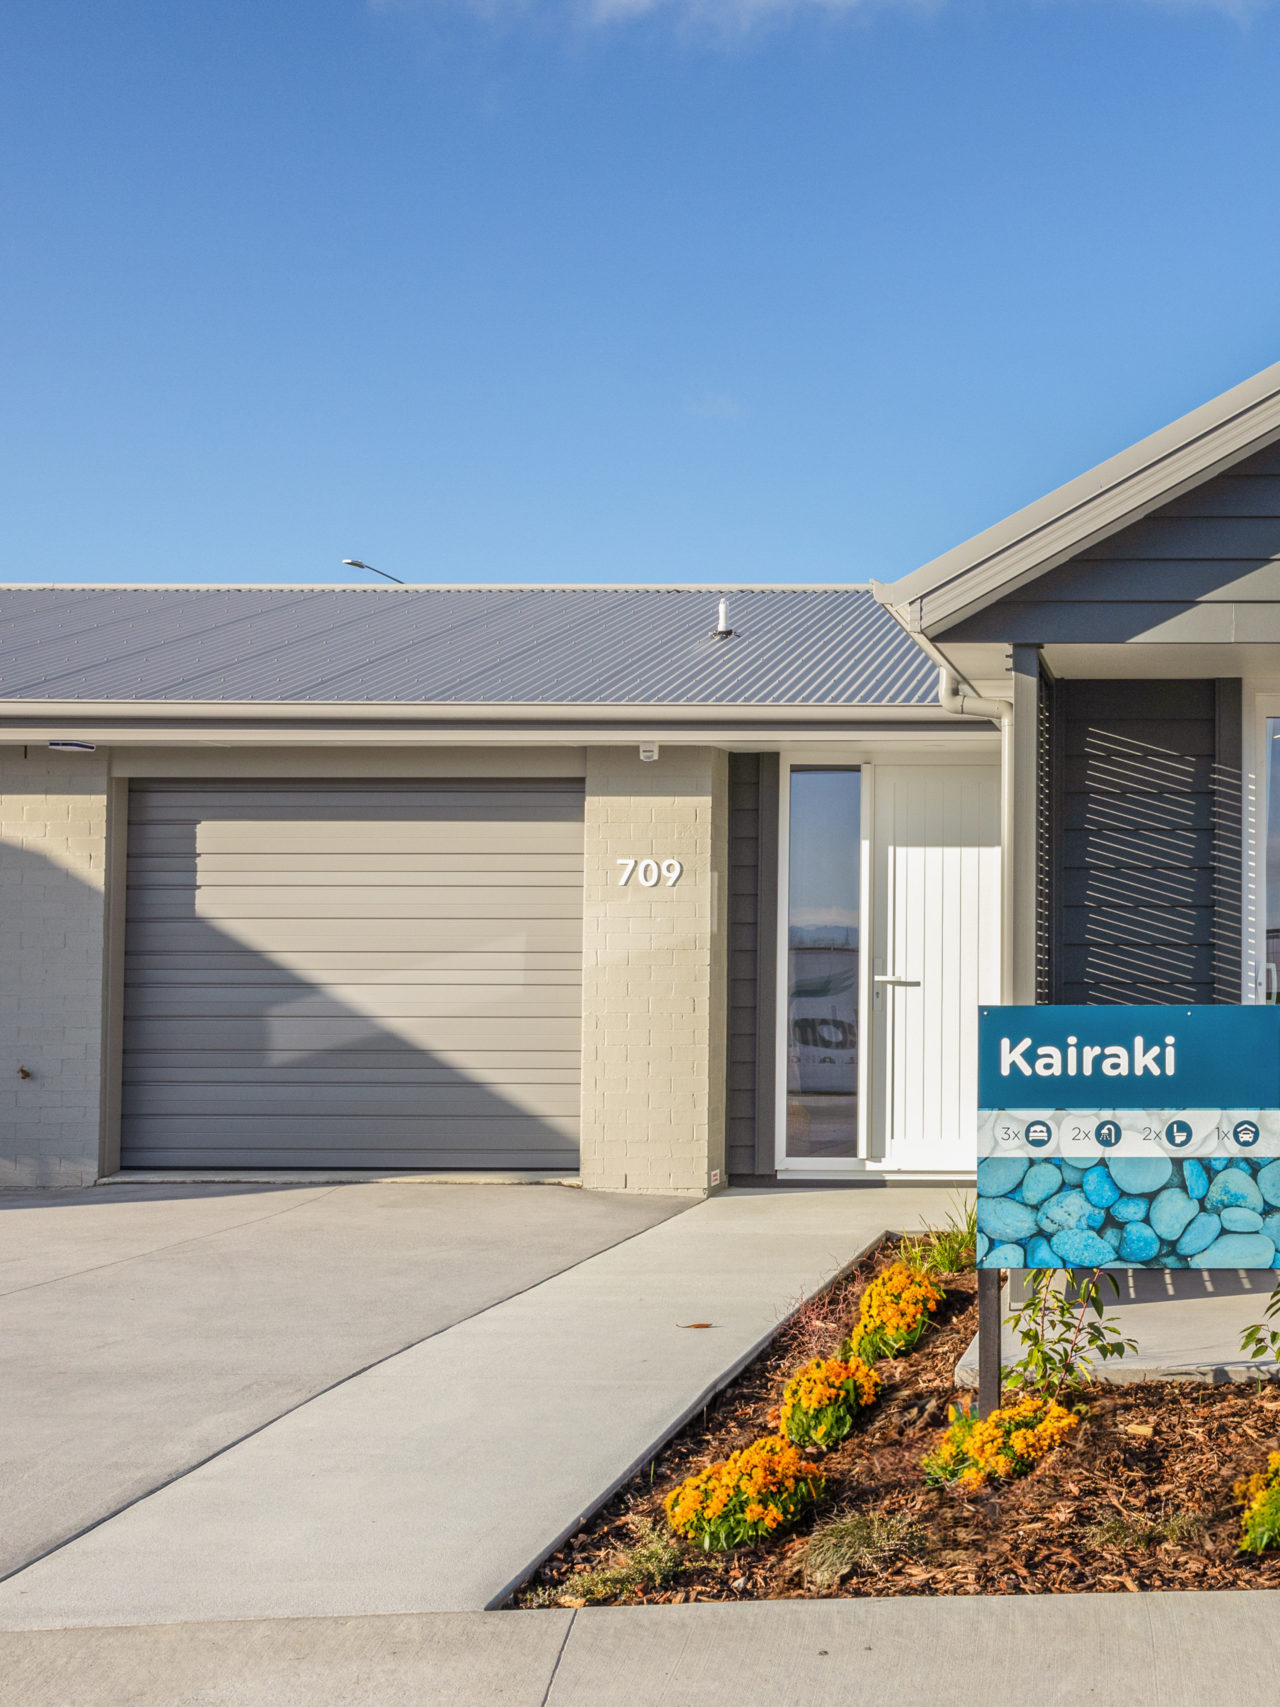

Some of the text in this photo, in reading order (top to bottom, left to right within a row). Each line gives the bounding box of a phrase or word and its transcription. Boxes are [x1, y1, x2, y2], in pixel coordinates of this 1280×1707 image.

[616, 858, 682, 887] 709
[1000, 1035, 1176, 1077] Kairaki
[1001, 1126, 1230, 1141] 3x 2x 2x 1x
